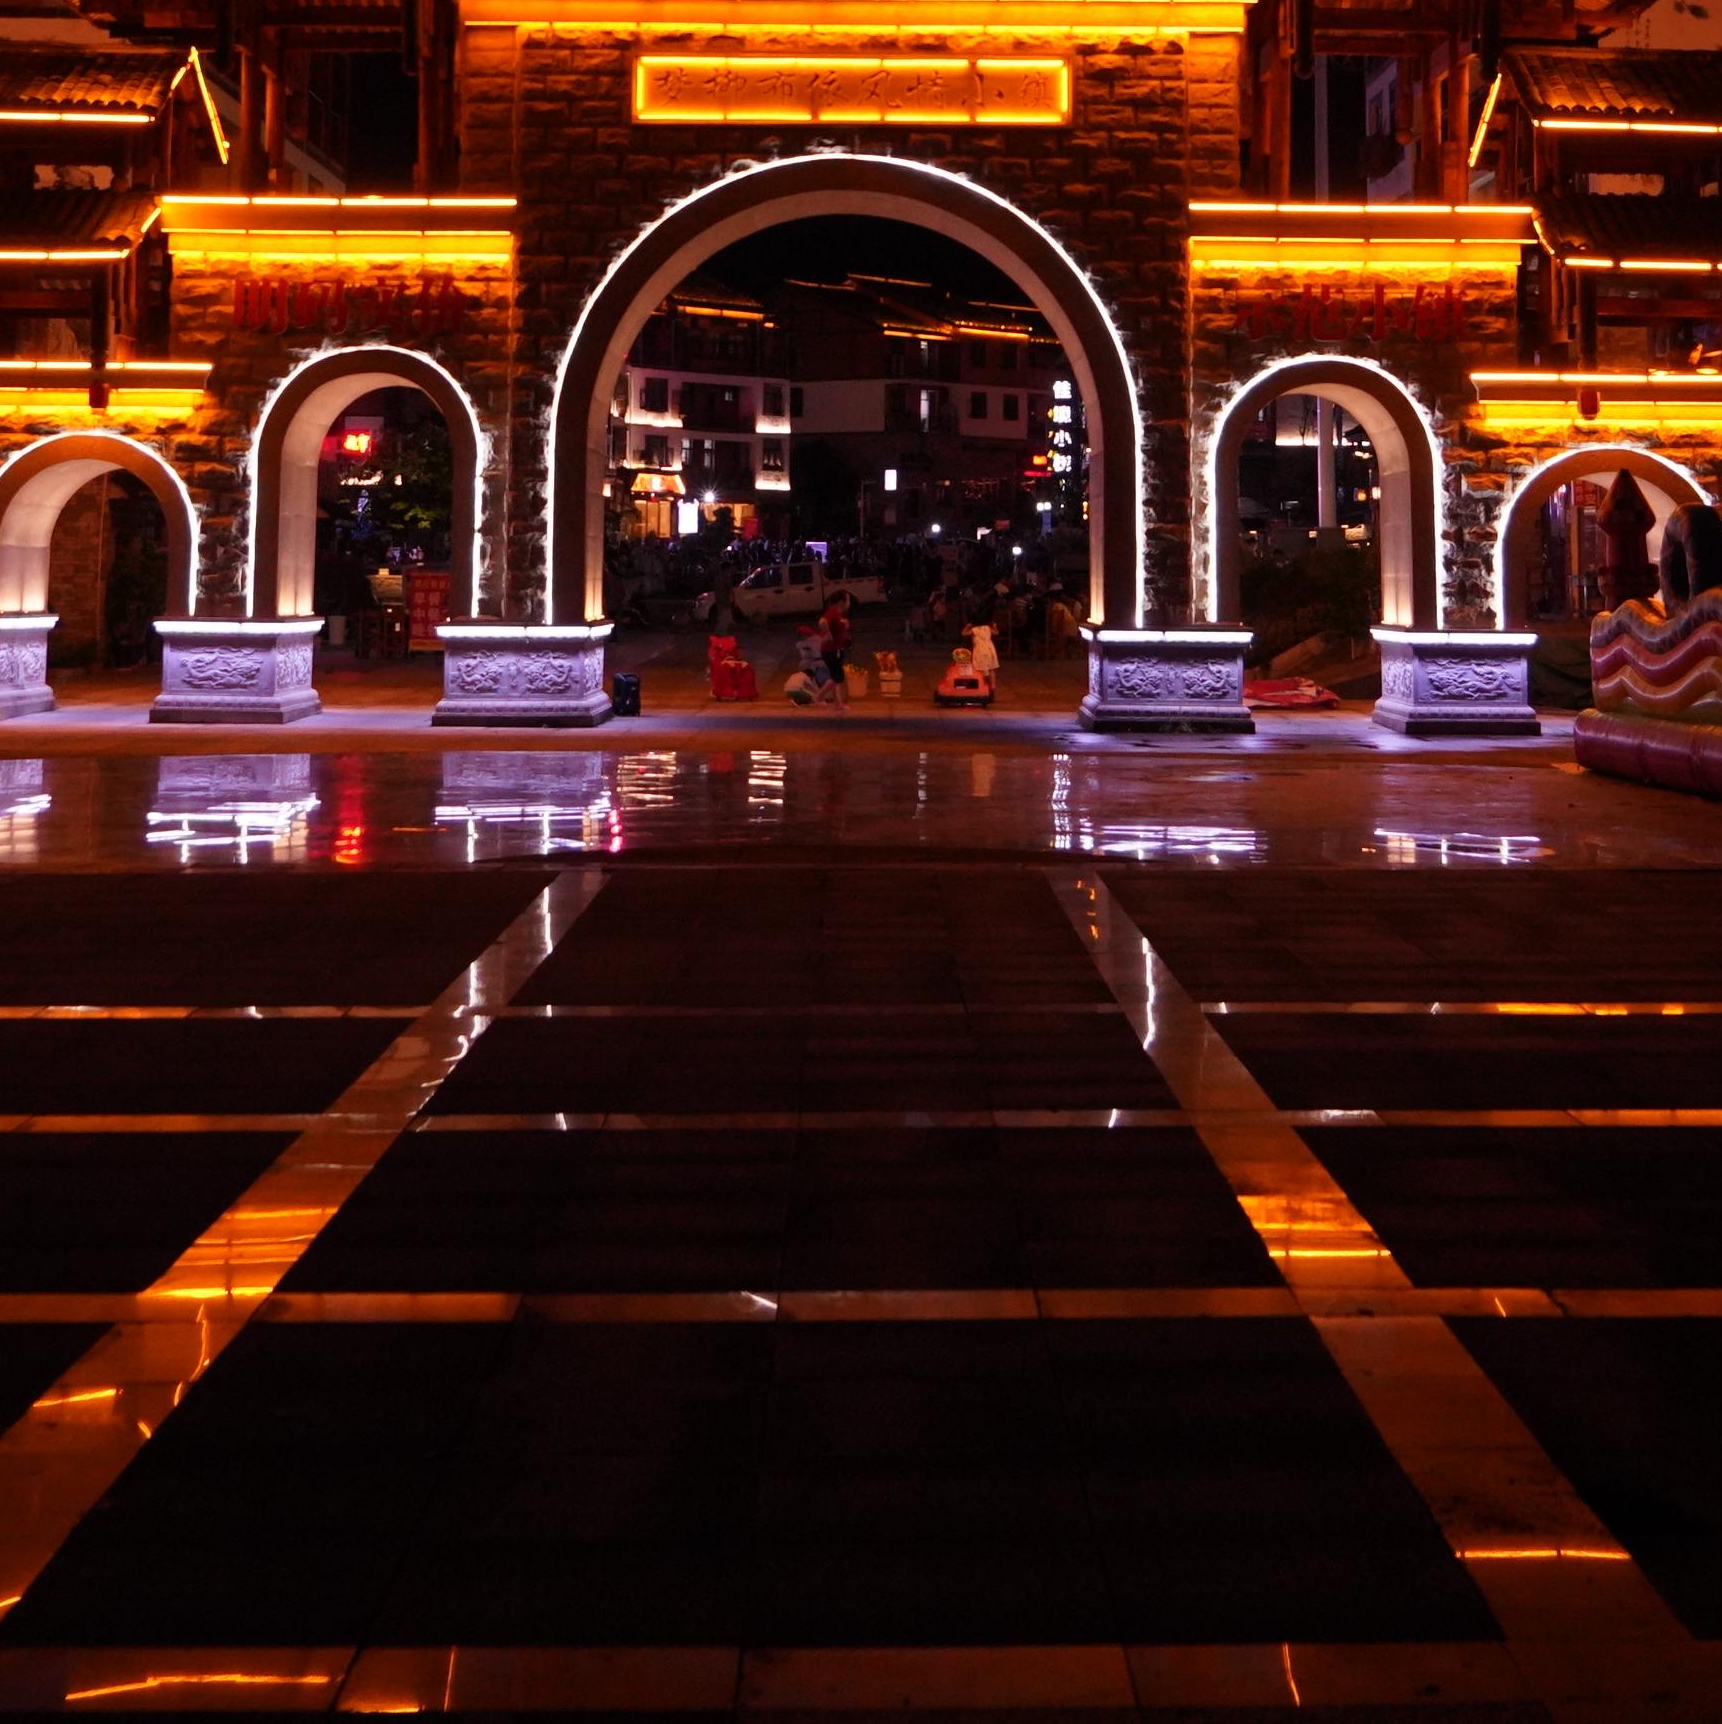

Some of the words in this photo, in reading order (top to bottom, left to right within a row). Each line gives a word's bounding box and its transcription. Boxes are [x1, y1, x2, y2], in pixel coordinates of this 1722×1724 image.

[652, 67, 1052, 109] 梦柳布依风情小镇
